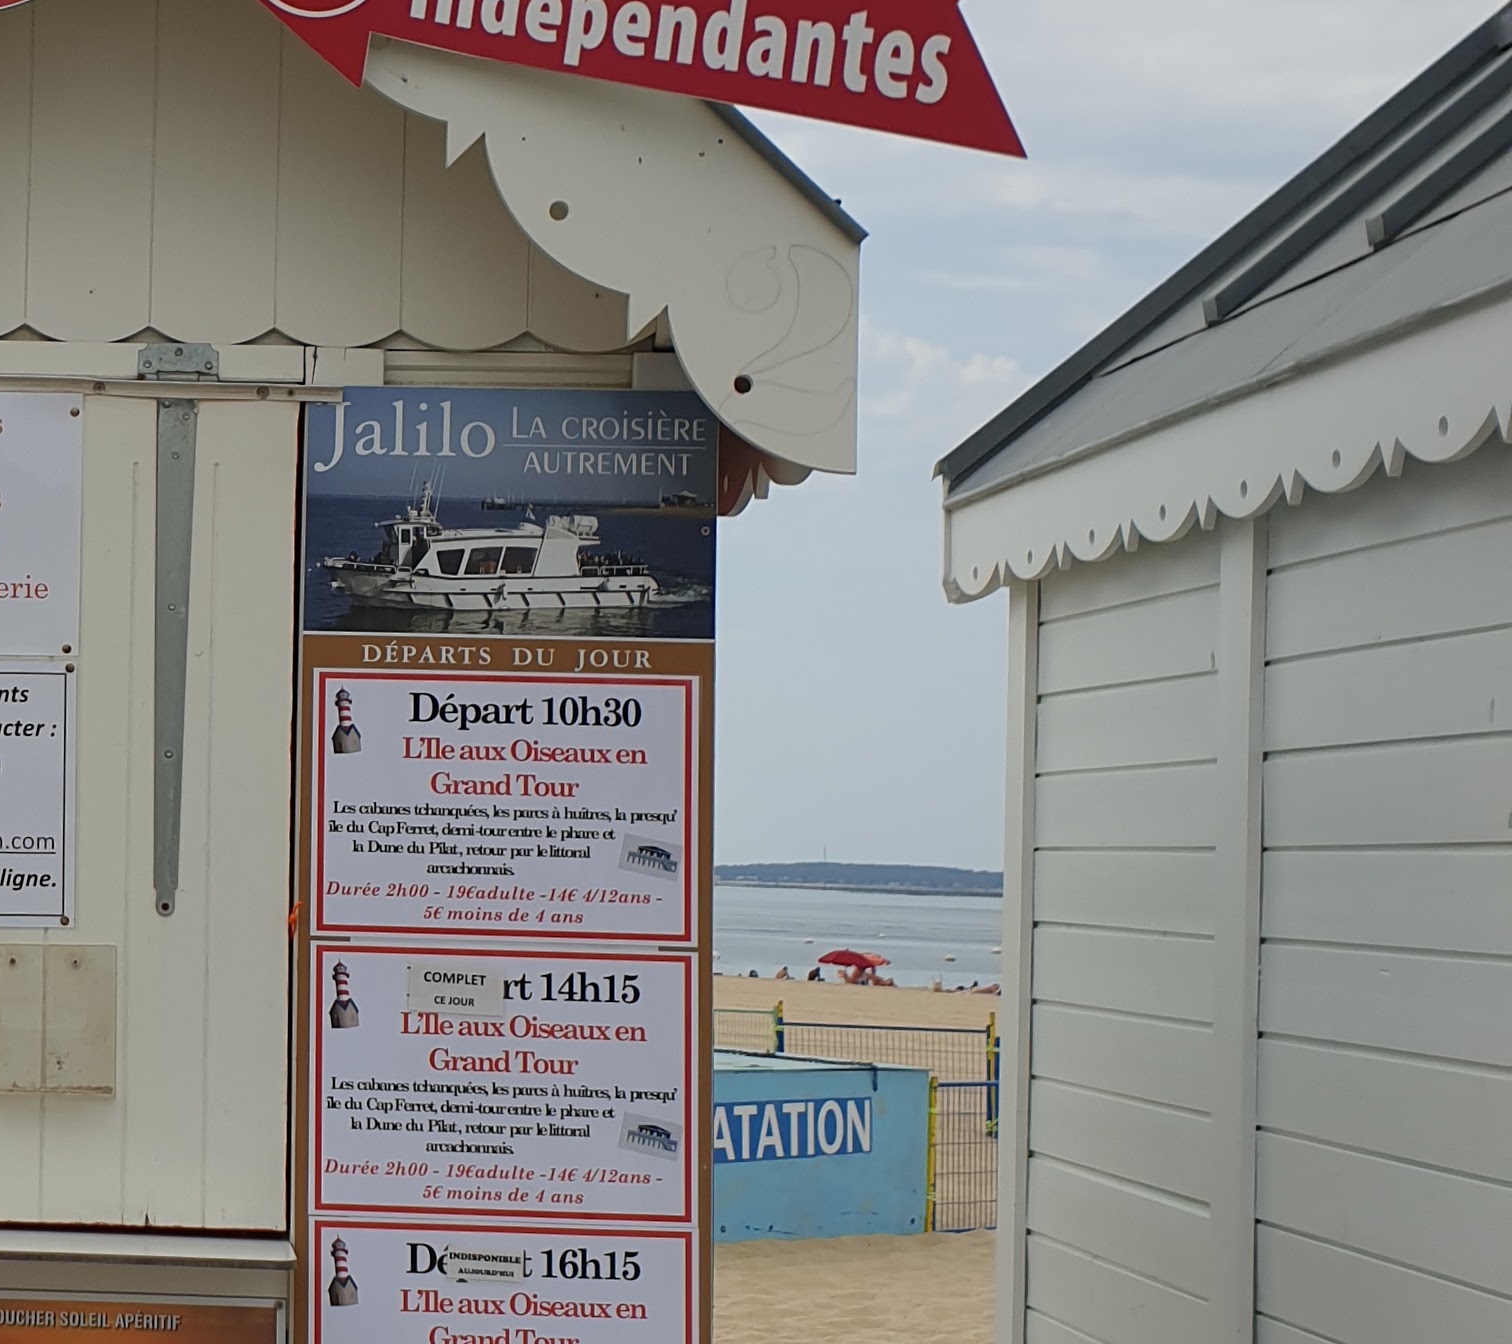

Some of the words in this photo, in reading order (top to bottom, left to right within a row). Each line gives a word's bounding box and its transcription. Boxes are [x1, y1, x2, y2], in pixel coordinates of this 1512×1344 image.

[315, 399, 496, 473] Jalilo
[523, 451, 692, 477] AUTREMENT
[362, 640, 492, 665] DÉPARTS
[513, 647, 555, 666] DU
[574, 649, 652, 672] JOUR
[409, 692, 533, 731] Départ
[542, 696, 641, 728] 10h30
[459, 742, 506, 761] aux
[510, 739, 612, 763] Oiseaux
[615, 747, 647, 764] en
[431, 771, 511, 796] Grand
[516, 774, 579, 798] Tour
[423, 971, 486, 986] COMPLET
[541, 972, 640, 1004] 14h15
[714, 1099, 870, 1160] ATATION
[449, 1251, 521, 1264] INDISPONIBLE
[541, 1248, 641, 1281] 16h15
[60, 1309, 110, 1330] SOLEIL
[115, 1309, 182, 1332] APÉRITIF
